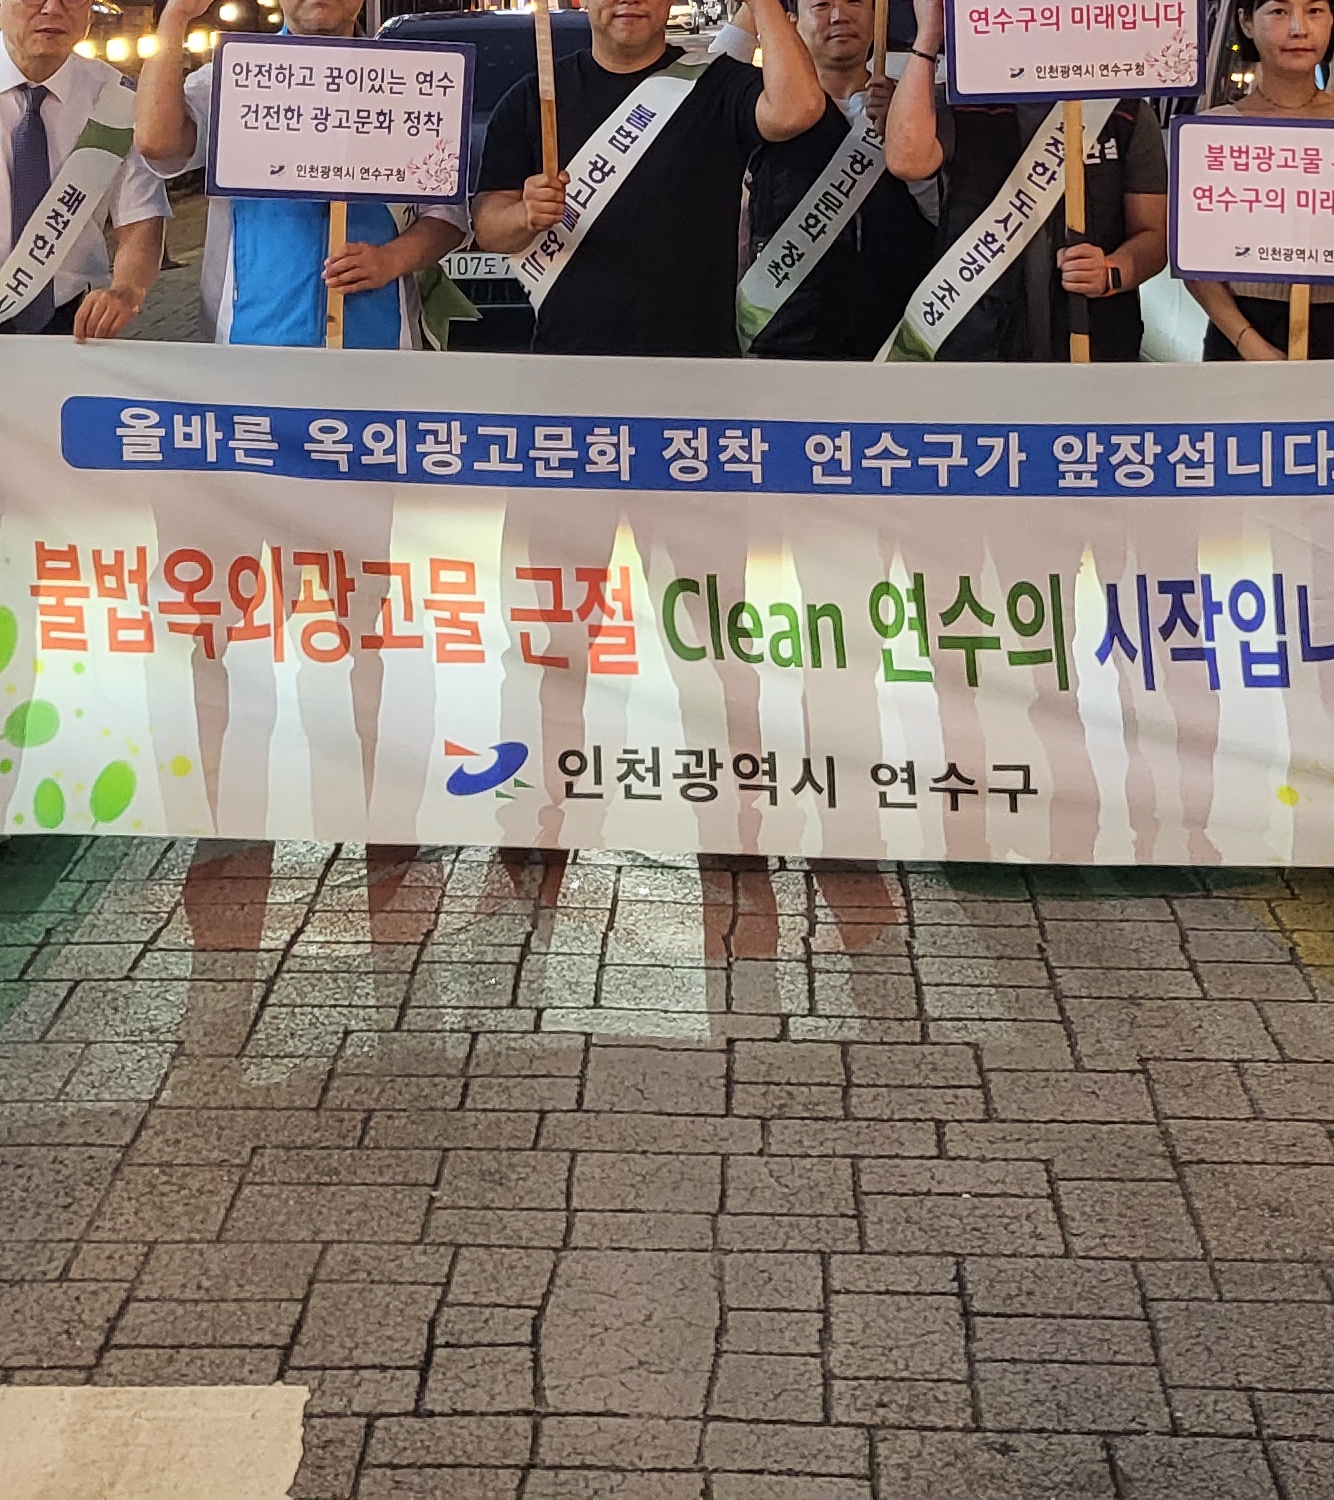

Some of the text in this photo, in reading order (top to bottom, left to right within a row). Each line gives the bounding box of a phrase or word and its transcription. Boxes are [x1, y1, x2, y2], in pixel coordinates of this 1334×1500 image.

[968, 1, 1186, 35] 연수구의 미래입니다
[231, 61, 456, 97] 안전하고 꿈이있는 연수
[1035, 61, 1146, 80] 인천광역시 연수구청
[239, 103, 444, 138] 건전한 광고문화 정착
[608, 103, 658, 154] 불법
[296, 163, 406, 183] 인천광역시 연수구청
[1204, 144, 1323, 175] 불법광고물
[798, 148, 875, 244] 광고문화
[1192, 184, 1286, 214] 연수구의
[28, 182, 88, 267] 쾌적한
[958, 187, 1038, 283] 도시환경
[520, 229, 565, 283] 없는
[767, 239, 805, 289] 정착
[1257, 246, 1319, 263] 인천광역시
[922, 278, 961, 327] 조성
[115, 406, 280, 469] 올바른
[303, 418, 636, 481] 옥외광고문화
[661, 426, 770, 484] 정착
[804, 428, 1026, 487] 연수구가
[29, 538, 487, 664] 불법옥외광고물
[510, 564, 640, 677] 근절
[661, 576, 847, 671] Clean
[869, 571, 1070, 693] 연수의
[557, 744, 1040, 815] 인천광역시 연수구
